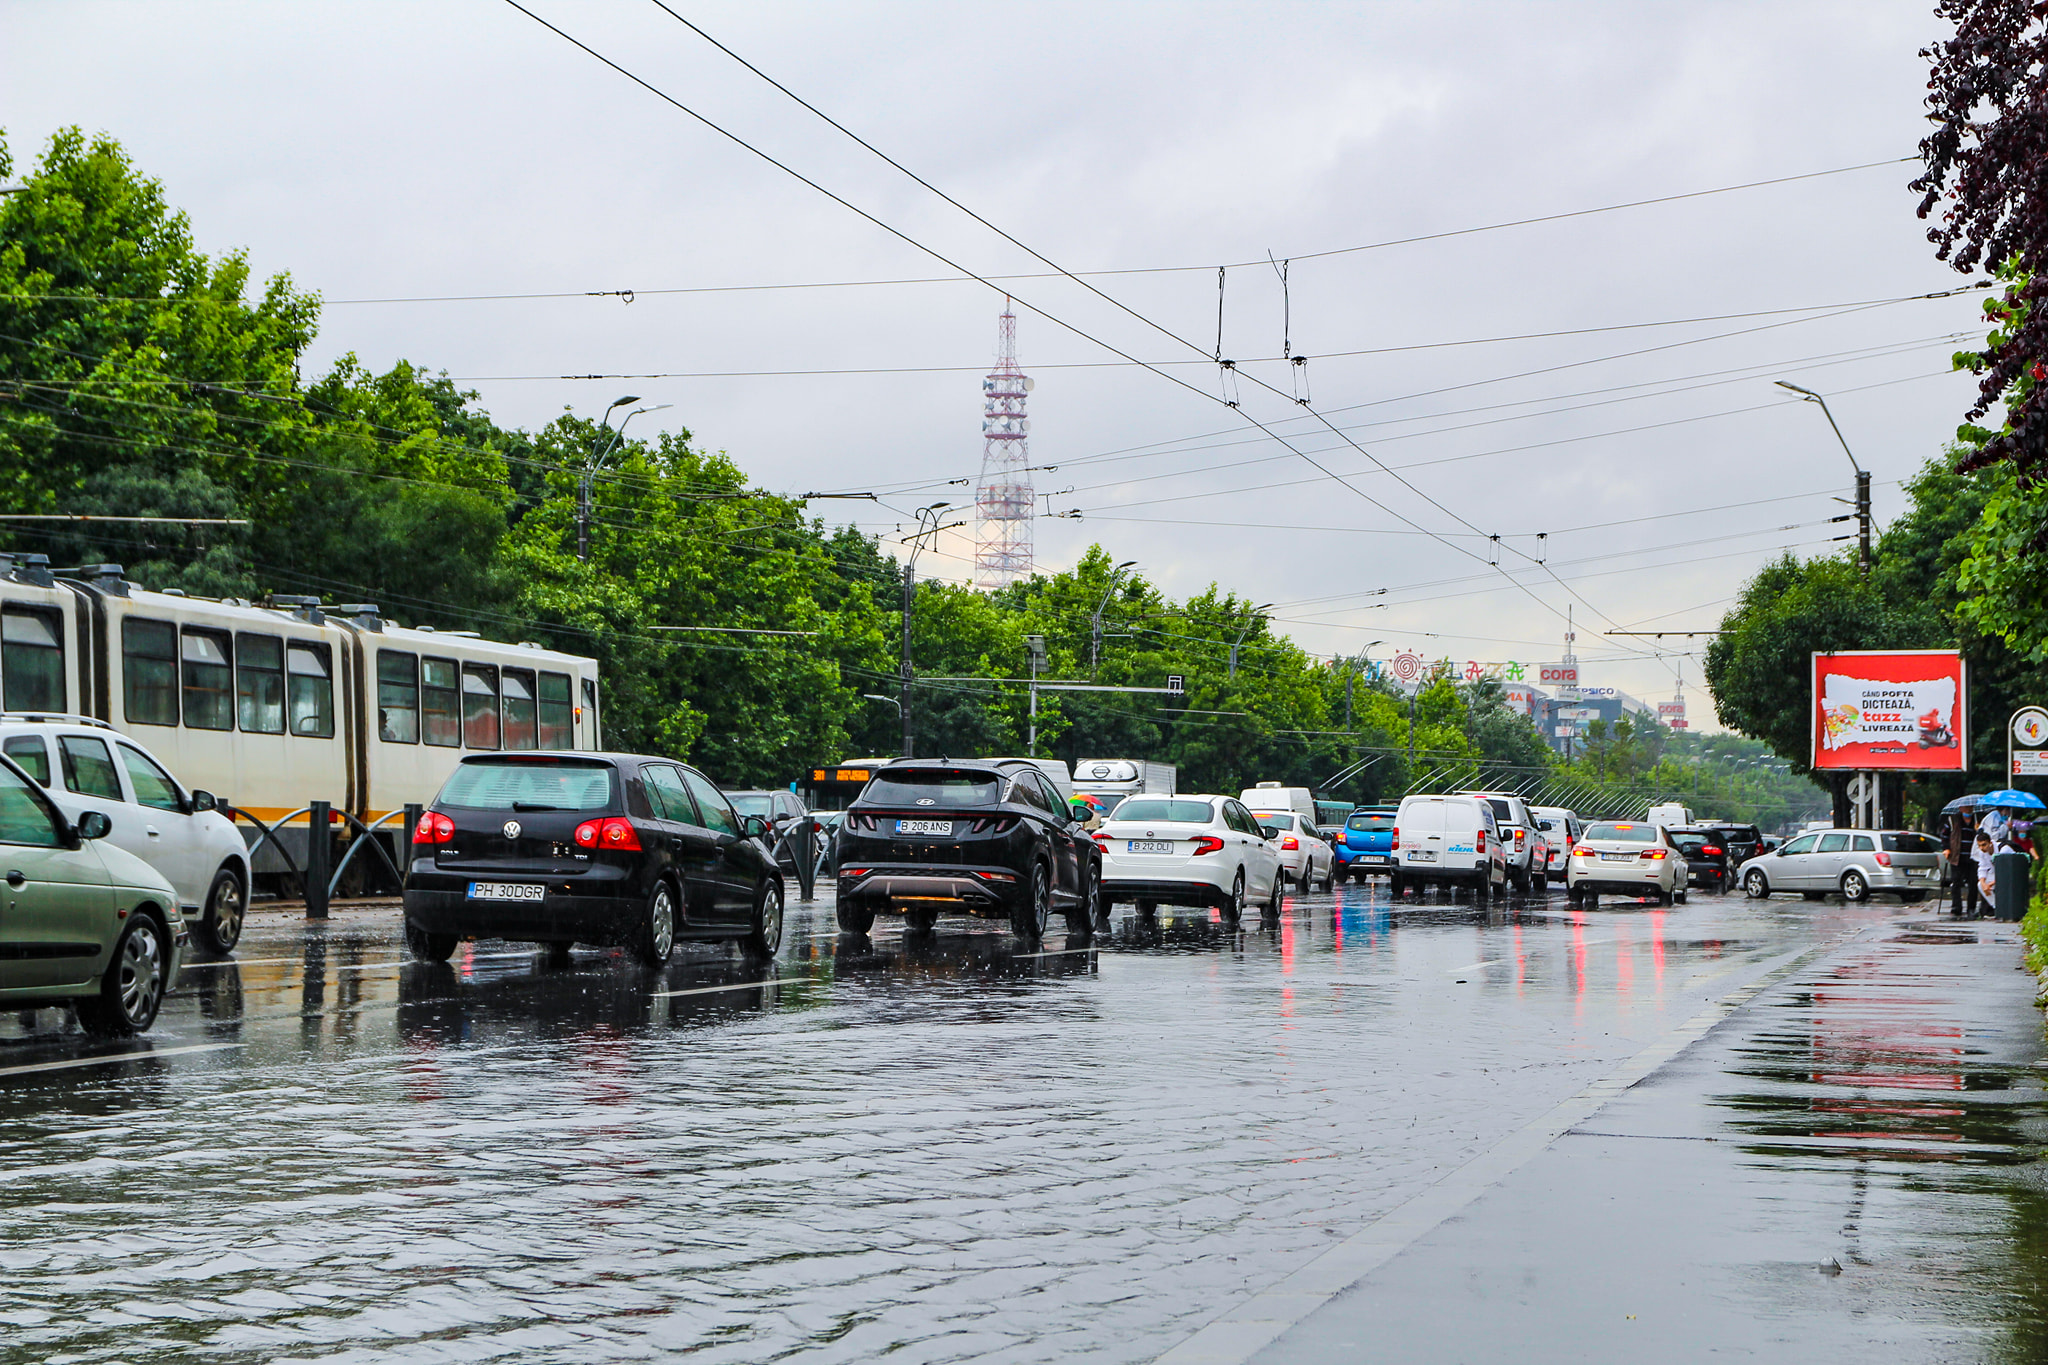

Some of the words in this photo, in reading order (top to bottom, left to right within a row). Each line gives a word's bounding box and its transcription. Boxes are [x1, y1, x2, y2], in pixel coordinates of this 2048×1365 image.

[1540, 668, 1577, 681] cora
[1658, 704, 1684, 714] cora
[1862, 711, 1902, 722] tazz
[901, 821, 908, 831] B
[911, 821, 929, 831] 206
[930, 821, 950, 832] ANS
[1142, 842, 1154, 851] 212
[474, 883, 493, 897] PH
